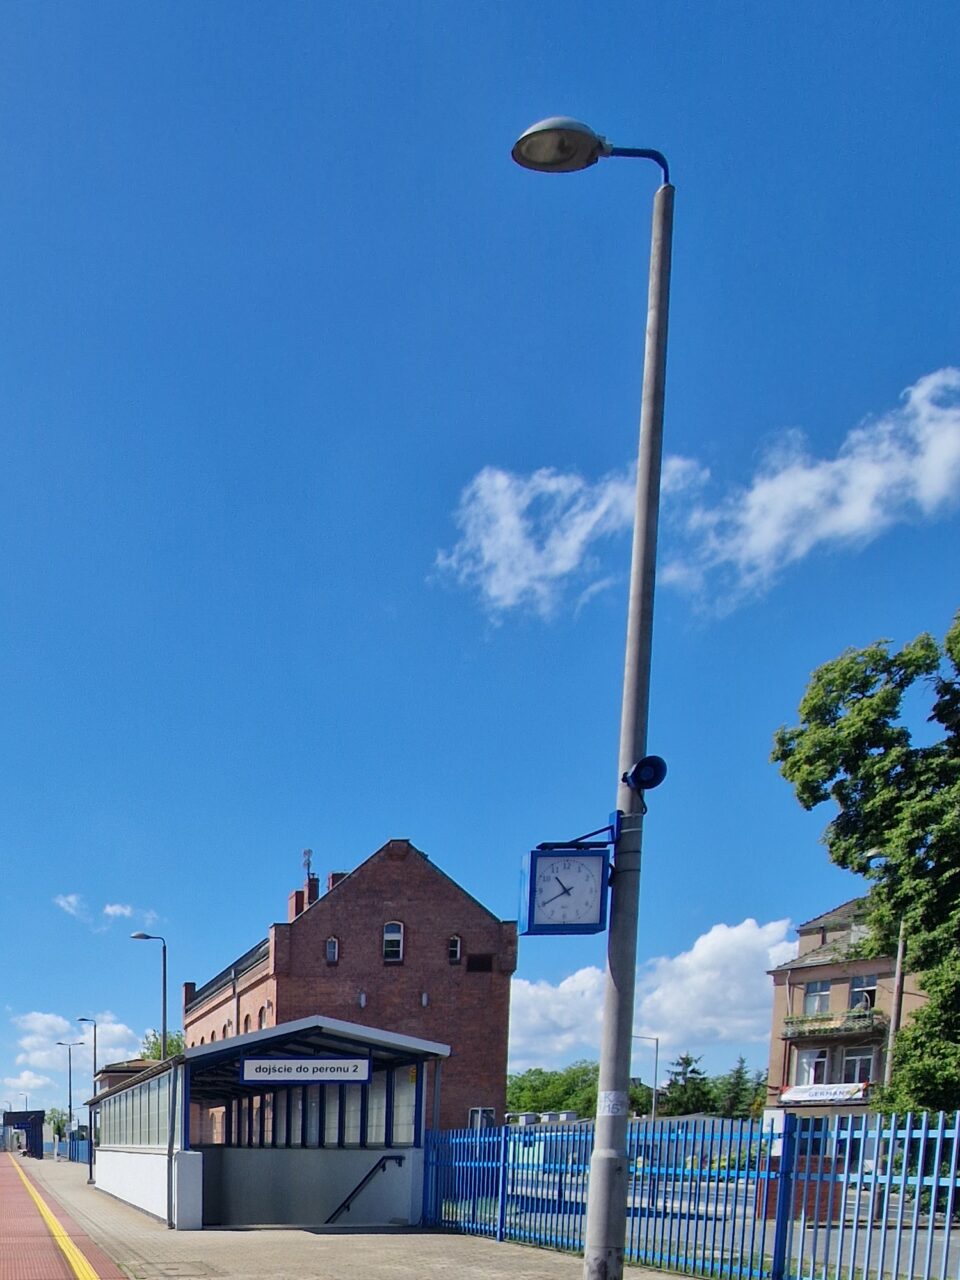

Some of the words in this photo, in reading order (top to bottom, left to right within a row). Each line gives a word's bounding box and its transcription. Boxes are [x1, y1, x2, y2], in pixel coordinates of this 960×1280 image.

[255, 1065, 293, 1075] dojście
[296, 1065, 309, 1073] do
[312, 1066, 349, 1075] peronu
[352, 1064, 359, 1073] 2
